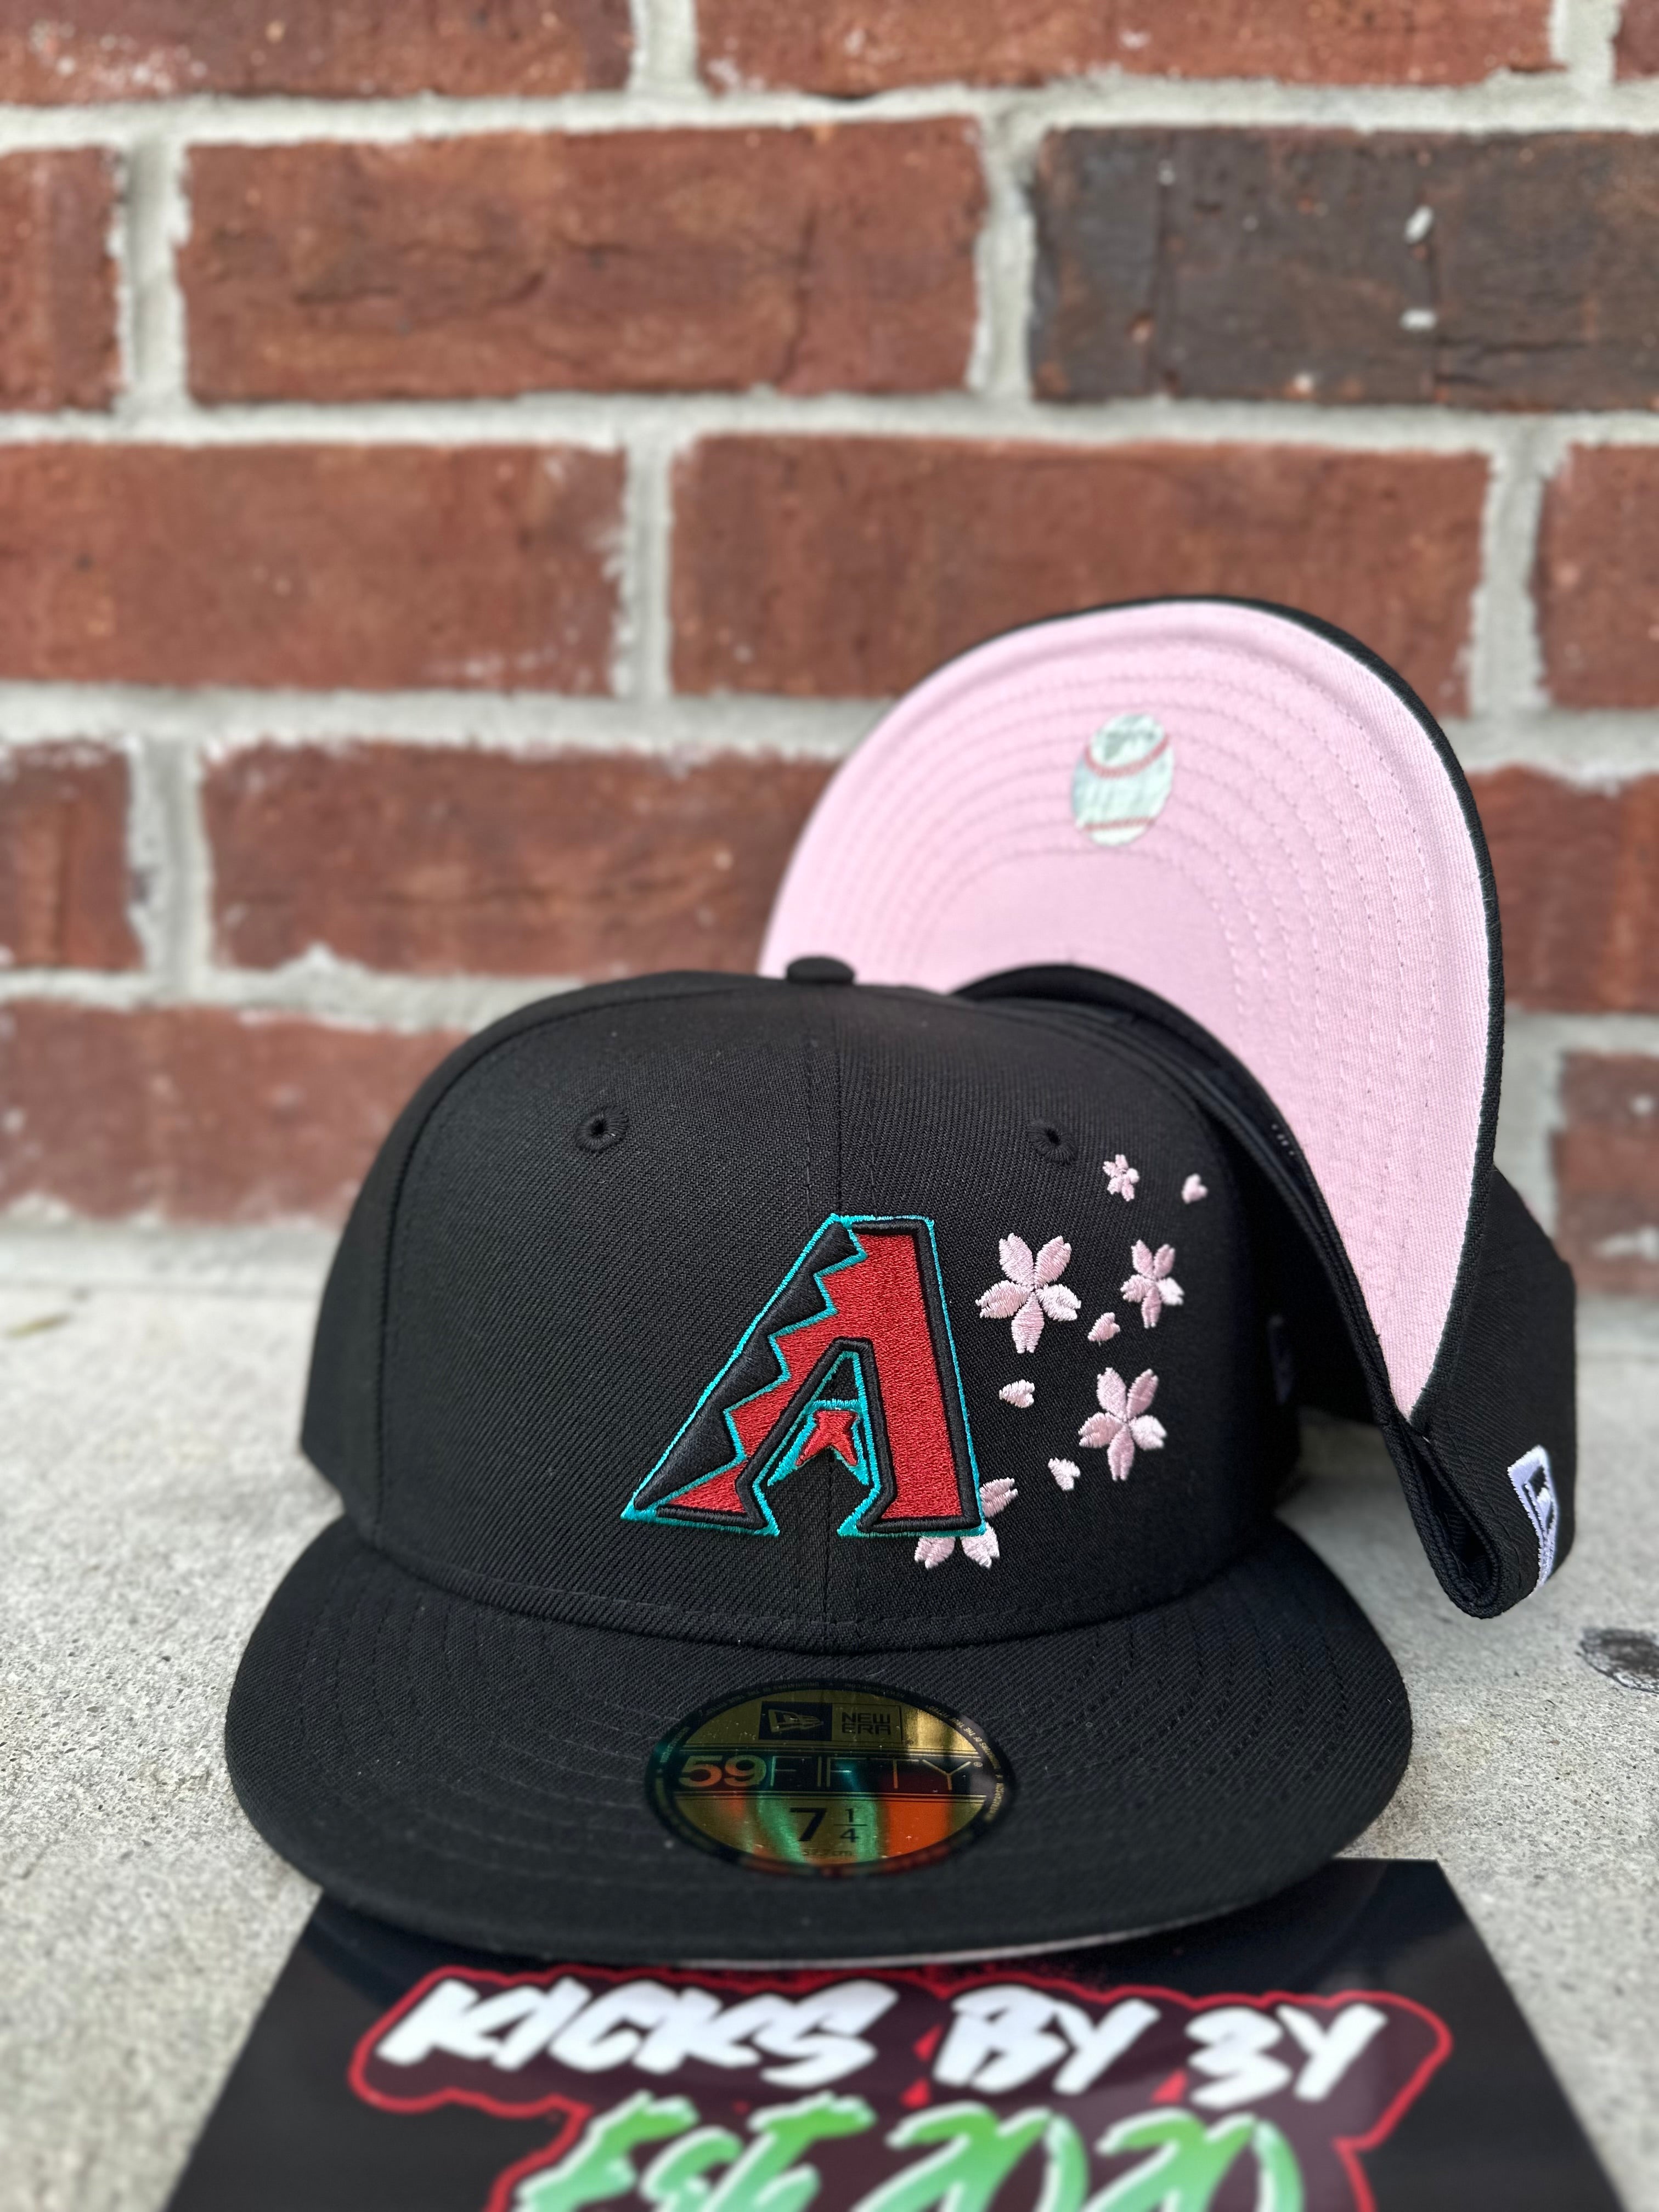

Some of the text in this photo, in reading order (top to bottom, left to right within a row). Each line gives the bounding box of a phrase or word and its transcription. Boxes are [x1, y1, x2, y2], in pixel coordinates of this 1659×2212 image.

[842, 1711, 891, 1723] NEW
[842, 1723, 891, 1735] ERA
[963, 1726, 976, 1736] THE
[789, 1807, 827, 1842] 7
[375, 1976, 1388, 2109] KICKS BY 3Y
